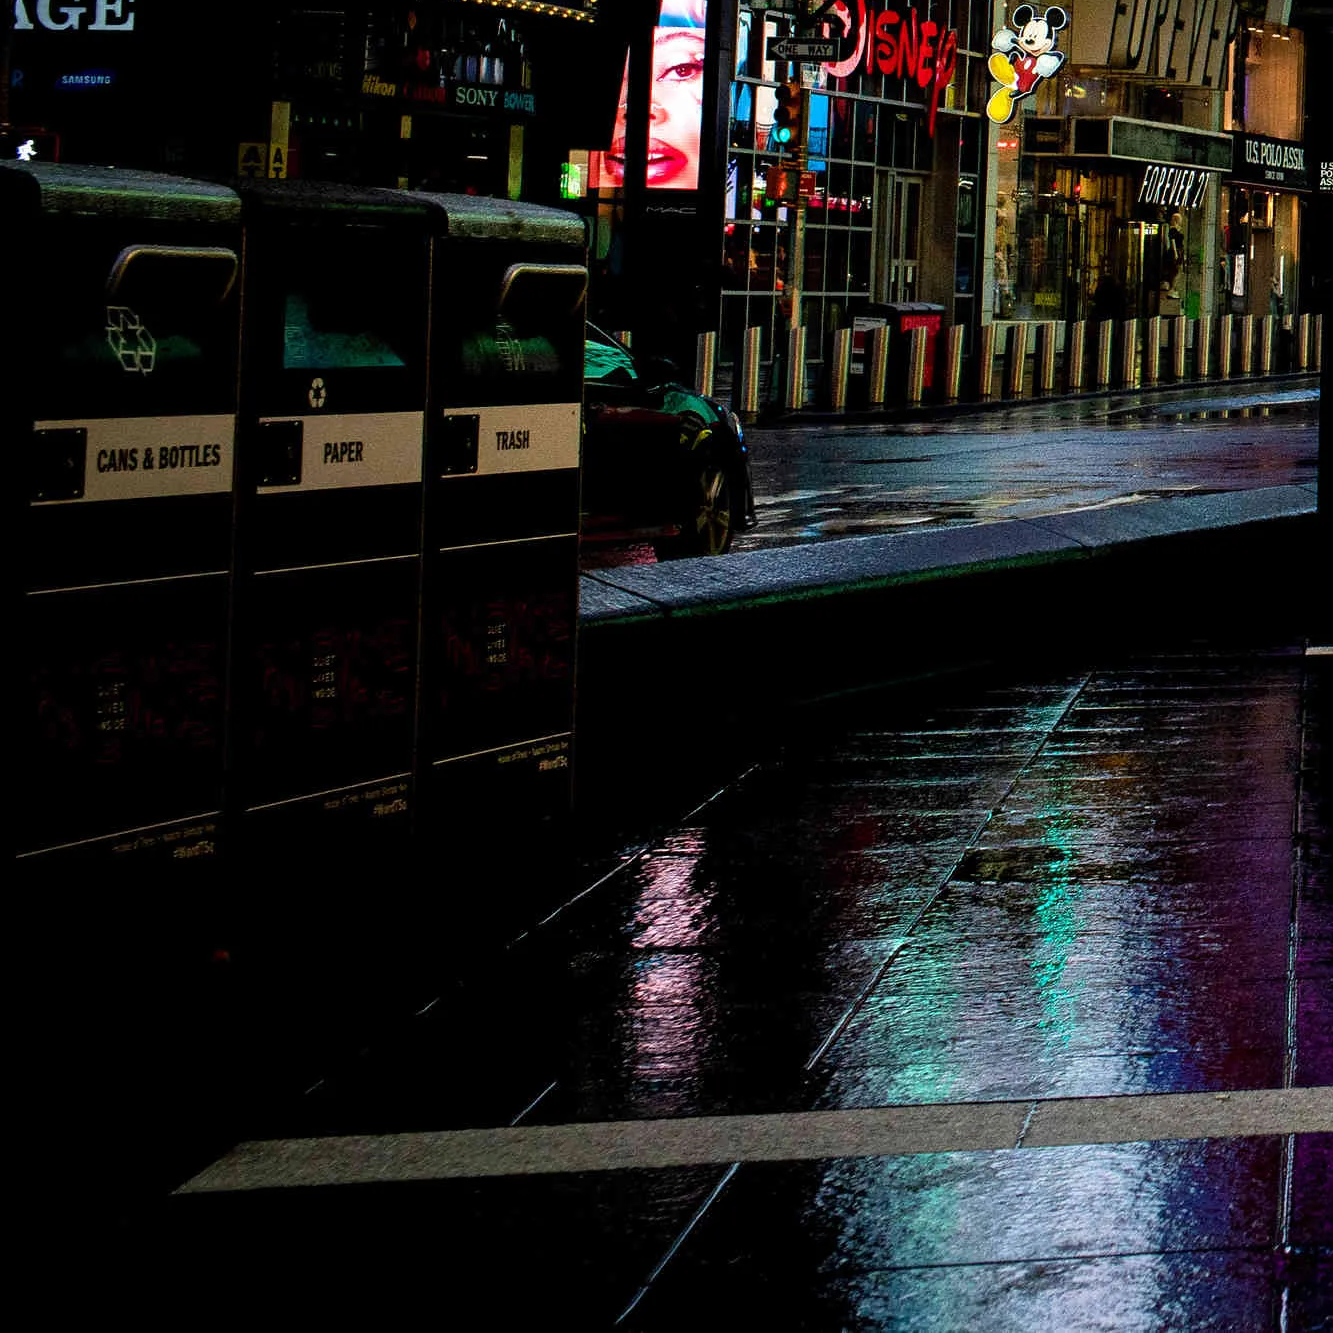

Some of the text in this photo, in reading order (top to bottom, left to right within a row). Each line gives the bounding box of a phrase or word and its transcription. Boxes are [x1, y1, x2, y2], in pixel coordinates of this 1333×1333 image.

[61, 74, 112, 86] SAMSUNG
[361, 74, 397, 97] Nikon
[455, 86, 498, 108] SONY
[1245, 139, 1307, 171] U.S. POLO ASSN.
[1137, 164, 1211, 210] FOREVER 21
[322, 441, 364, 465] PAPER
[494, 430, 531, 452] TRASH
[97, 443, 222, 475] CANS & BOTTLES
